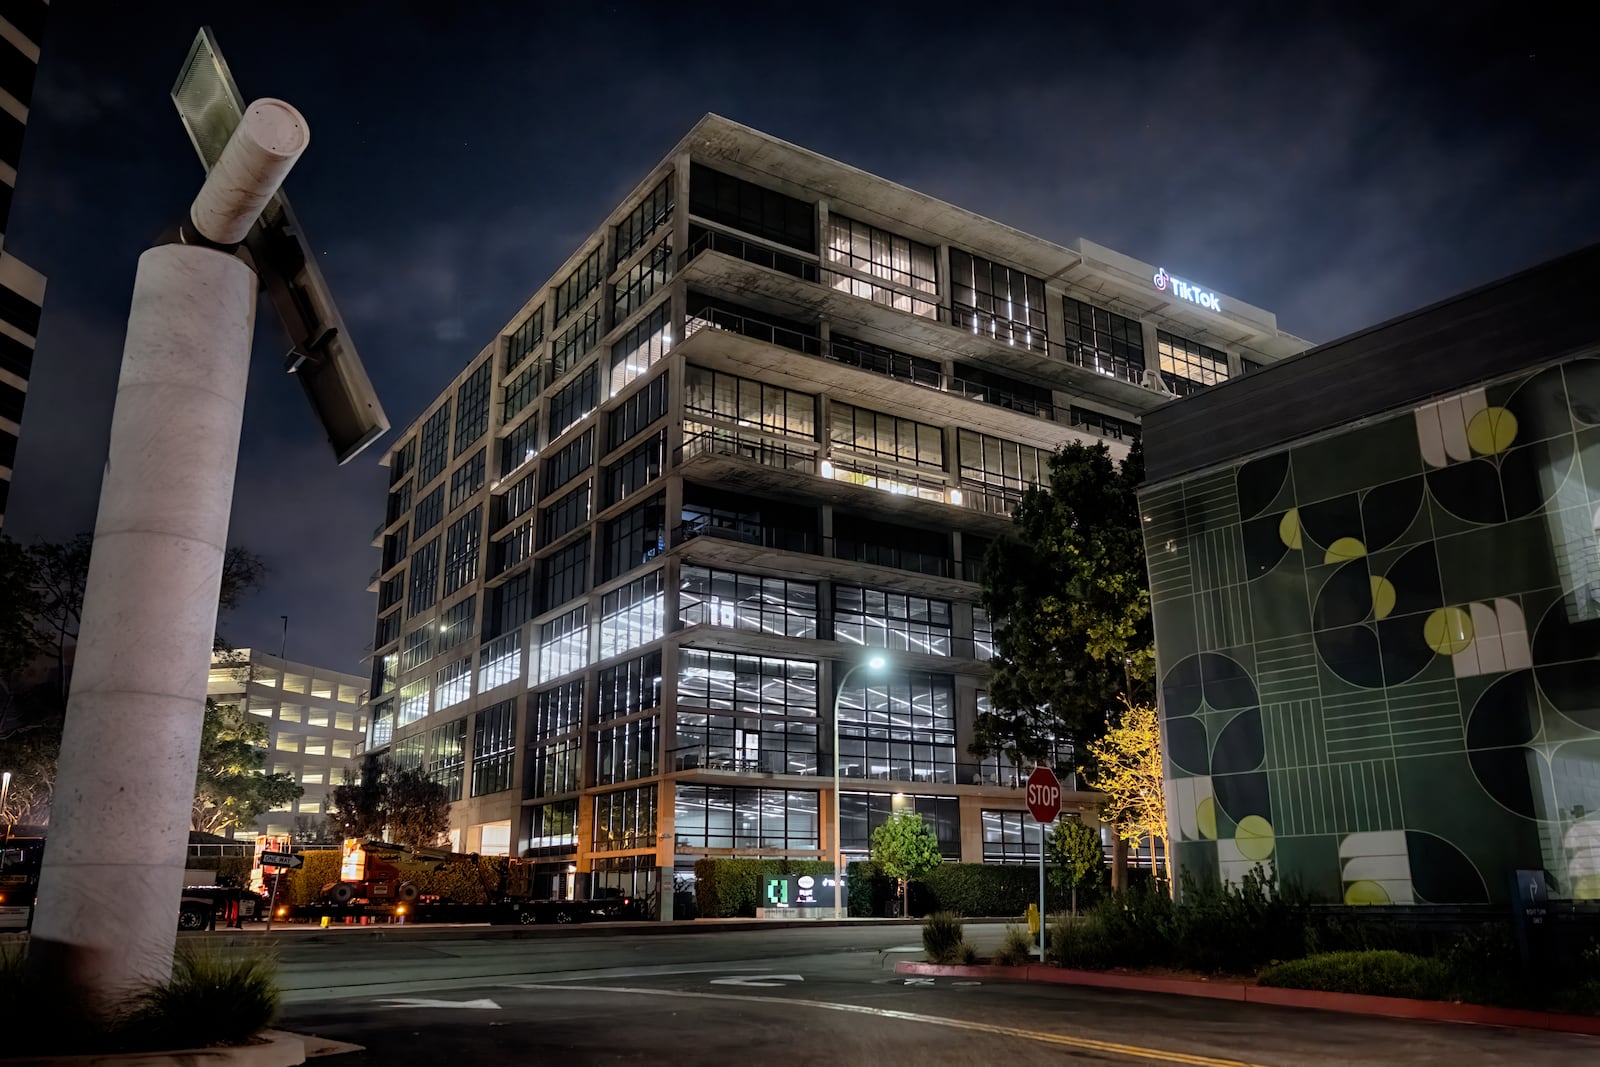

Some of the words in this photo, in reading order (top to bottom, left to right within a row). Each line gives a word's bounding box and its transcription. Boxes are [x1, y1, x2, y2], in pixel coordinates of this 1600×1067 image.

[1170, 277, 1221, 312] TikTok
[1028, 783, 1059, 807] STOP
[279, 856, 290, 864] WAY
